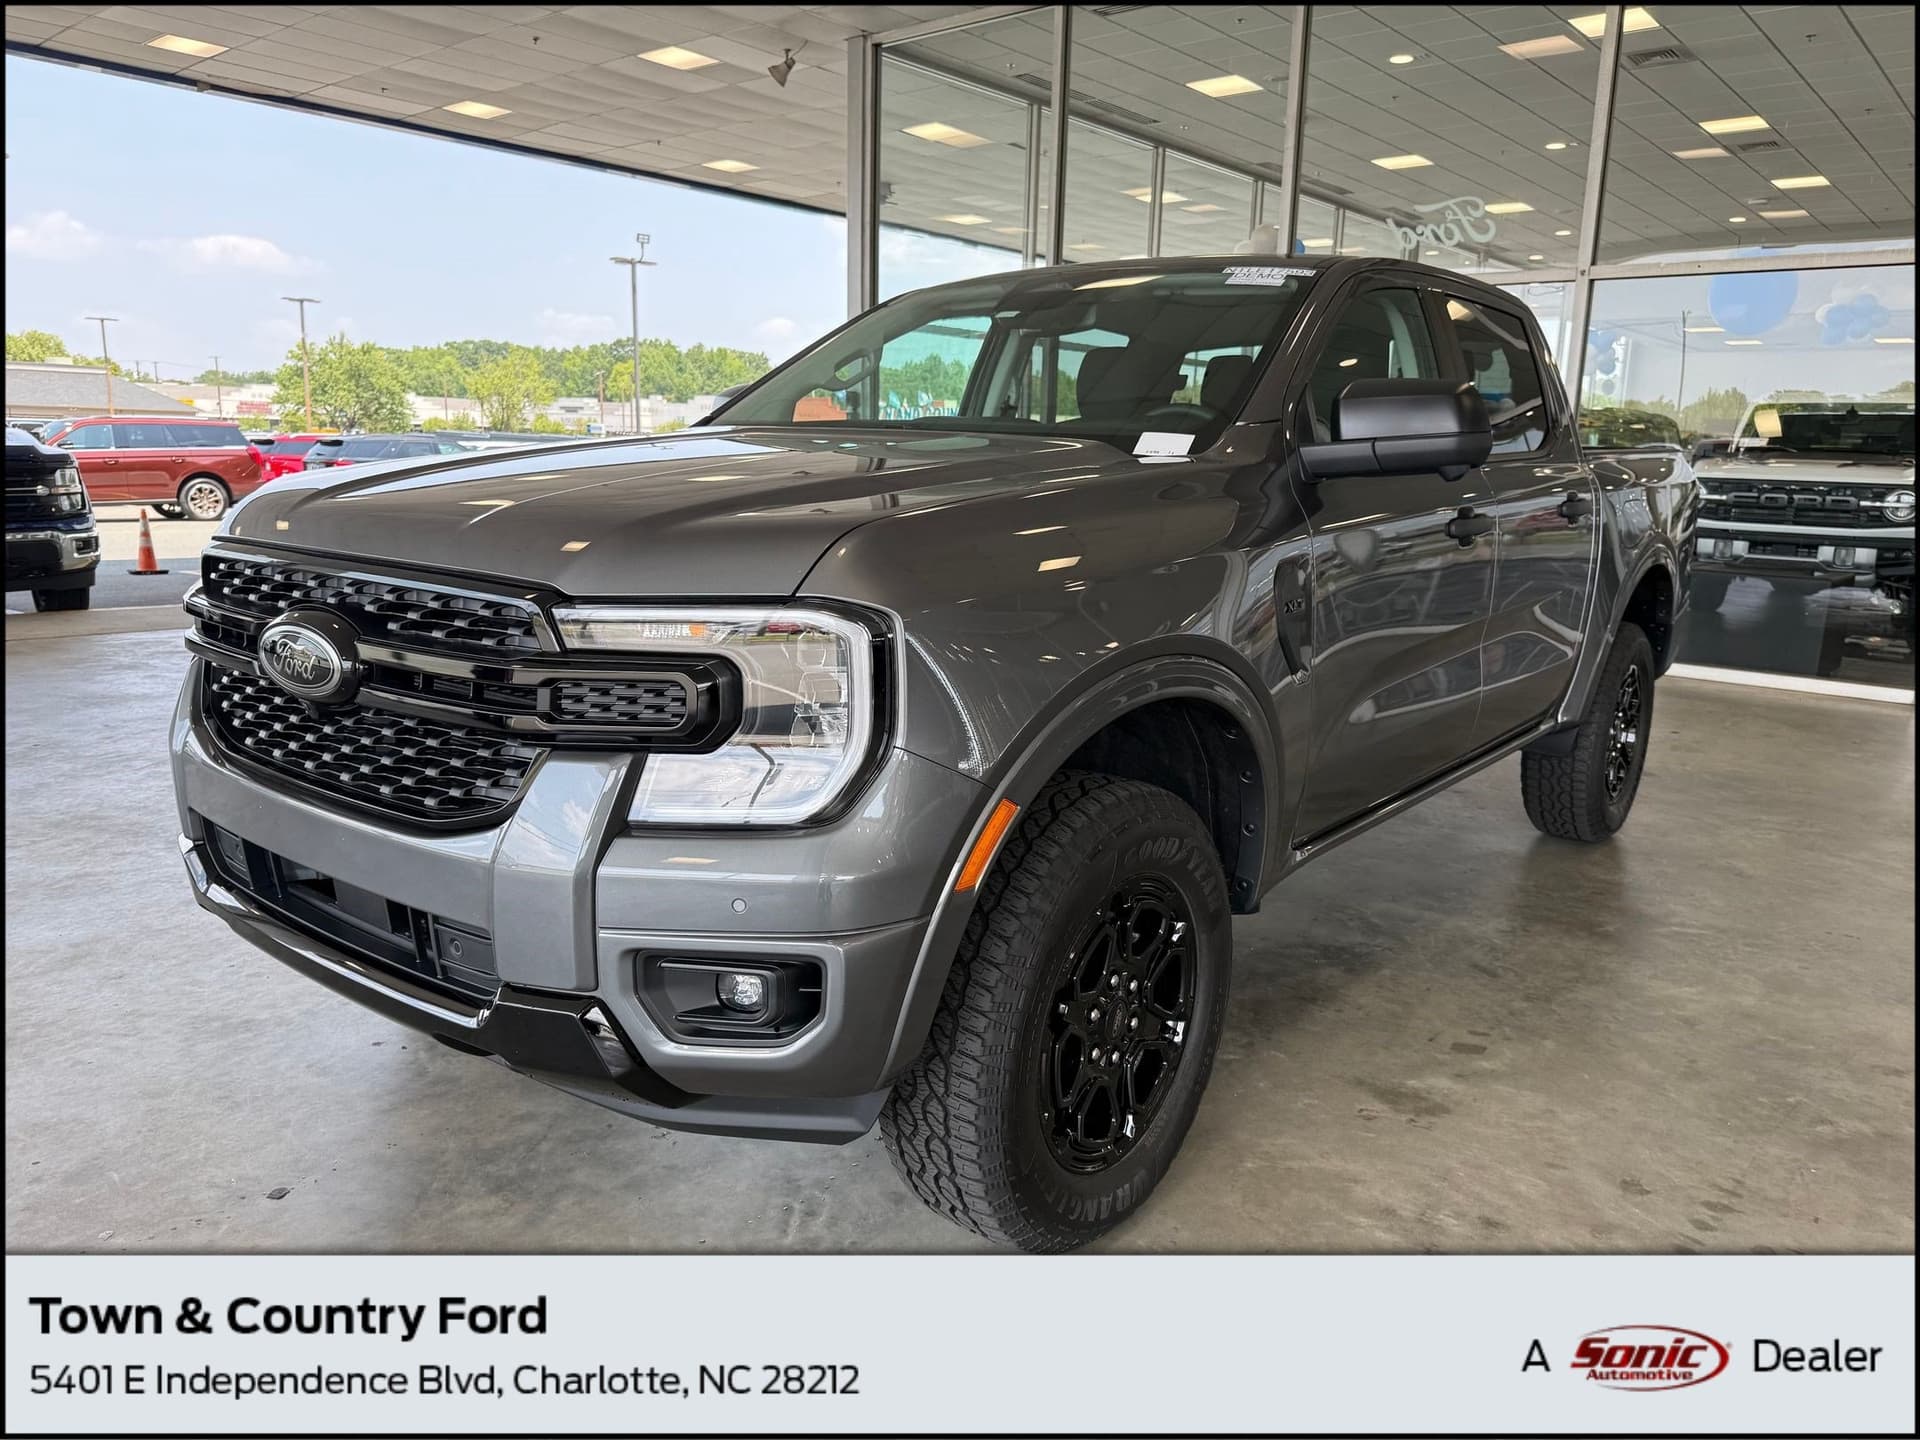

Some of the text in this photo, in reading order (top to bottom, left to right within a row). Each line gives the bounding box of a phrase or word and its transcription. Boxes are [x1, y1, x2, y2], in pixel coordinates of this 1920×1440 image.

[1234, 272, 1285, 280] DEMO
[1726, 491, 1859, 510] FORD
[273, 637, 316, 680] Ford
